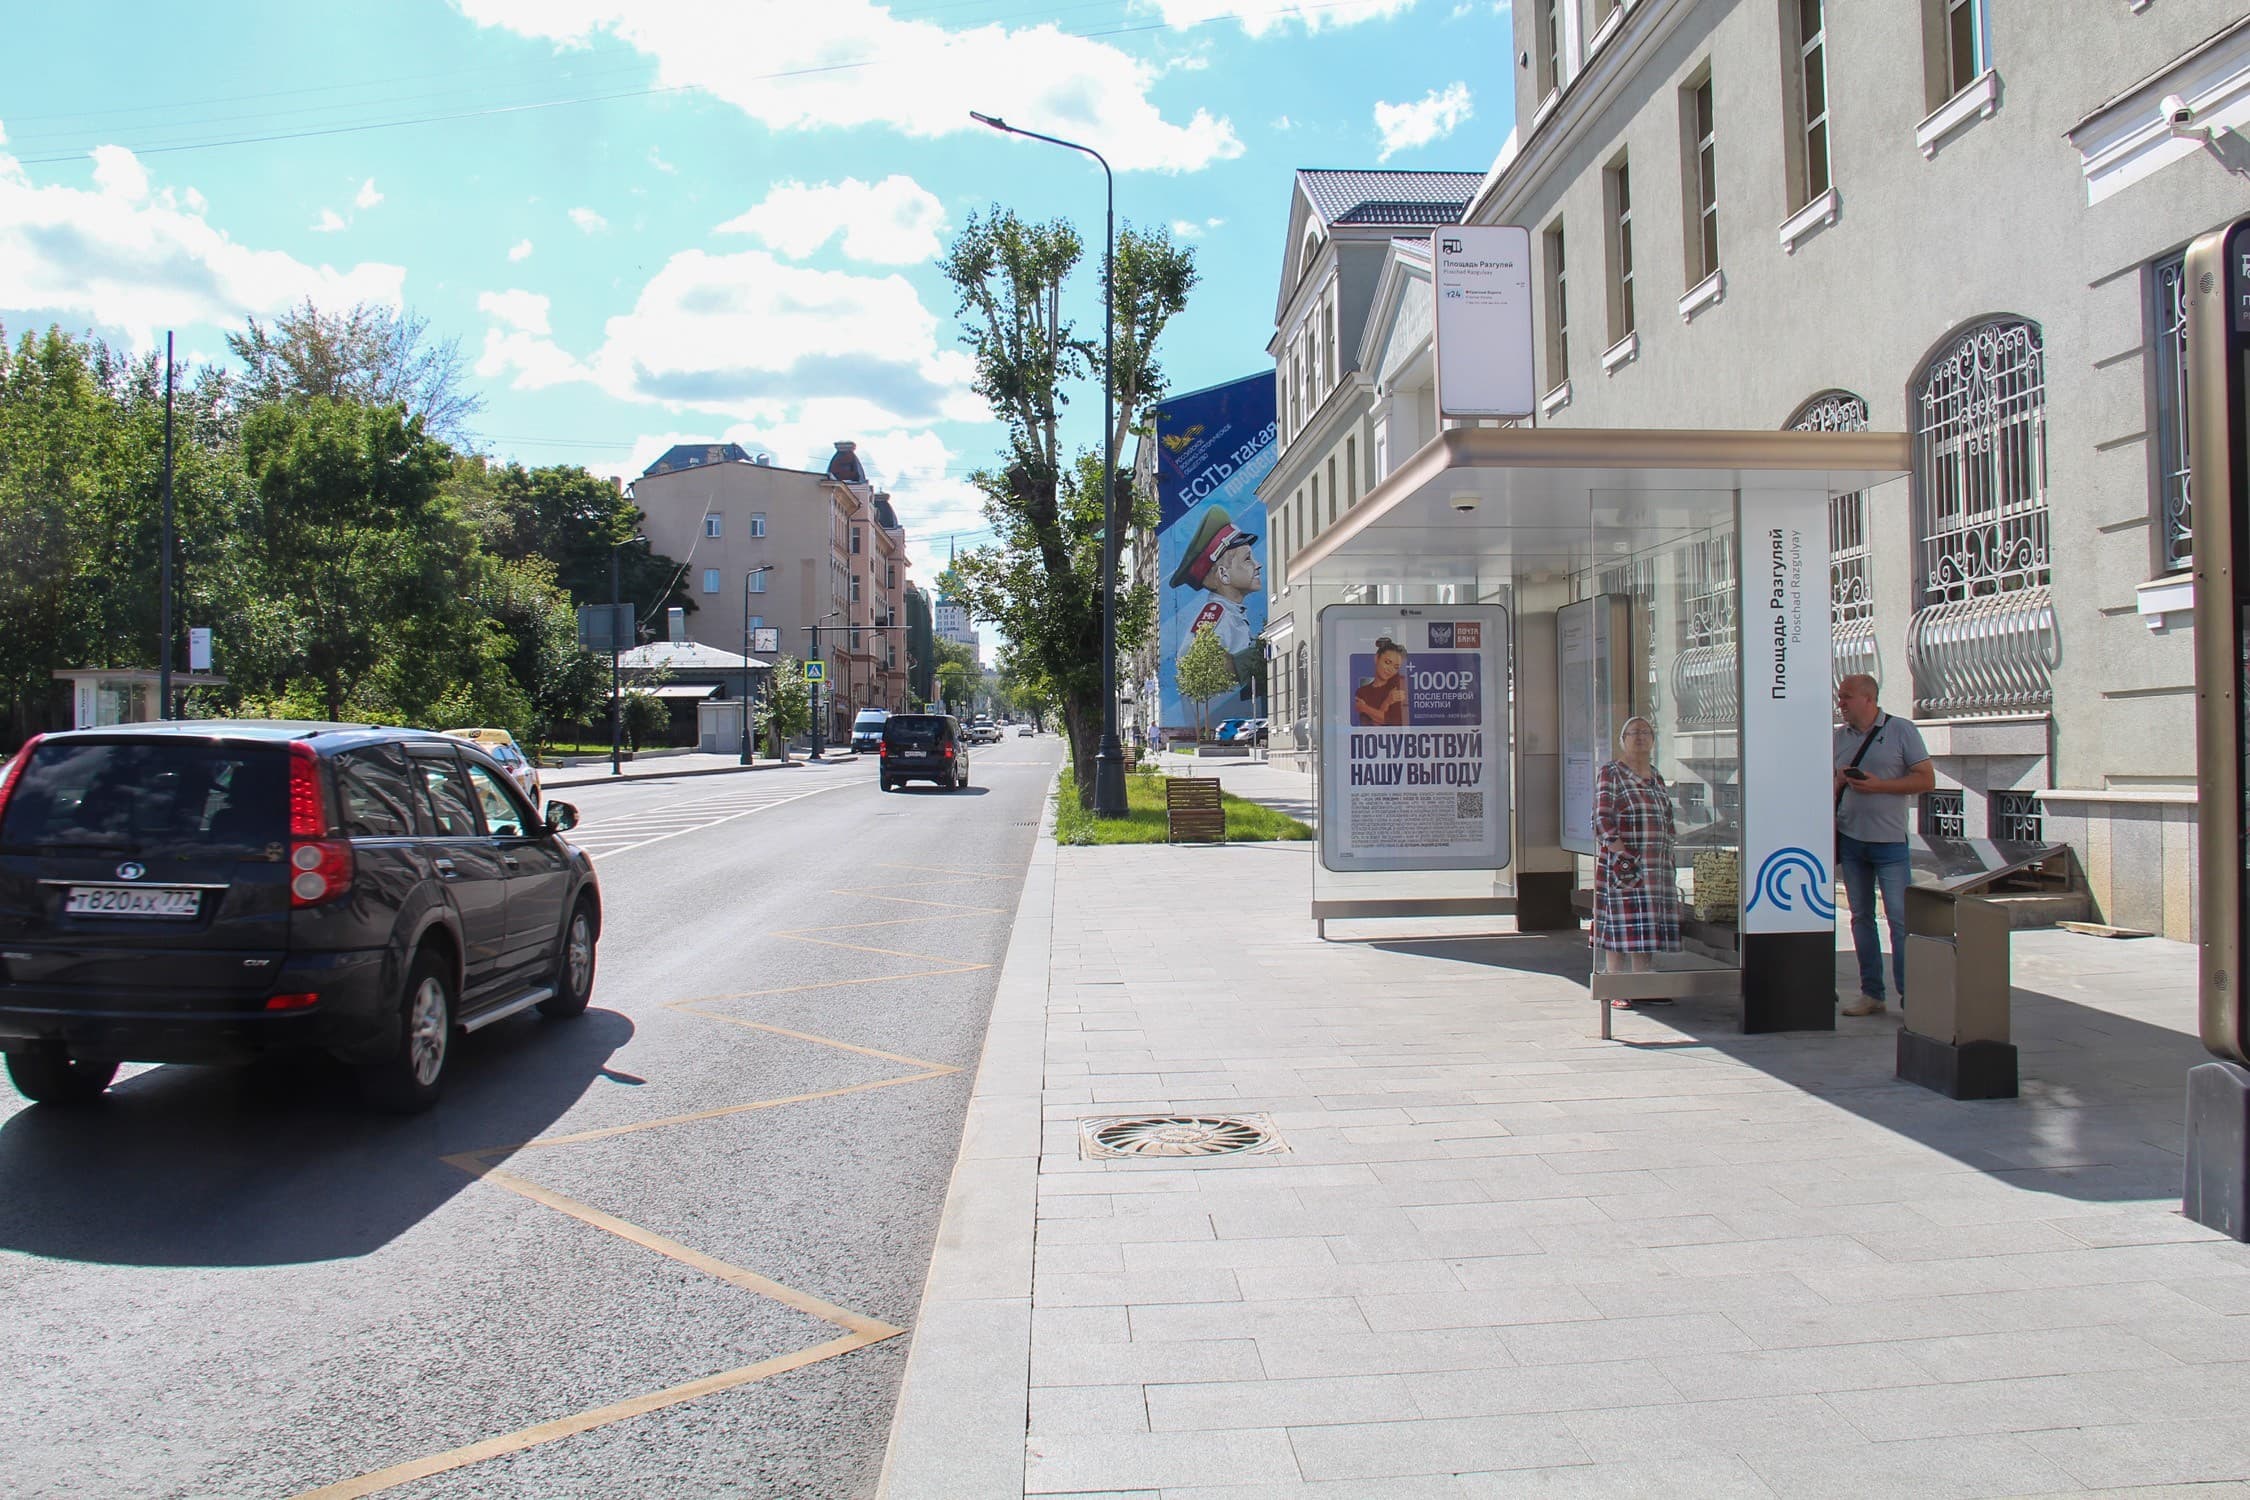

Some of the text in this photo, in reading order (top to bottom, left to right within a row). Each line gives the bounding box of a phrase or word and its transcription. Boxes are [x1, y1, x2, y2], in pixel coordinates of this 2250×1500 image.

[1443, 260, 1513, 269] Площадь Разгуляй
[1178, 421, 1278, 508] ЕСТЬ такая
[1790, 530, 1803, 643] Ploschad Razgulyay
[1768, 528, 1787, 699] Площадь Разгуляй
[1414, 701, 1451, 709] ПОКУПКИ
[1442, 692, 1474, 700] ПЕРВОЙ
[1350, 729, 1482, 759] ПОЧУВСТВУЙ
[1350, 762, 1482, 787] НАШУ ВЫГОДУ
